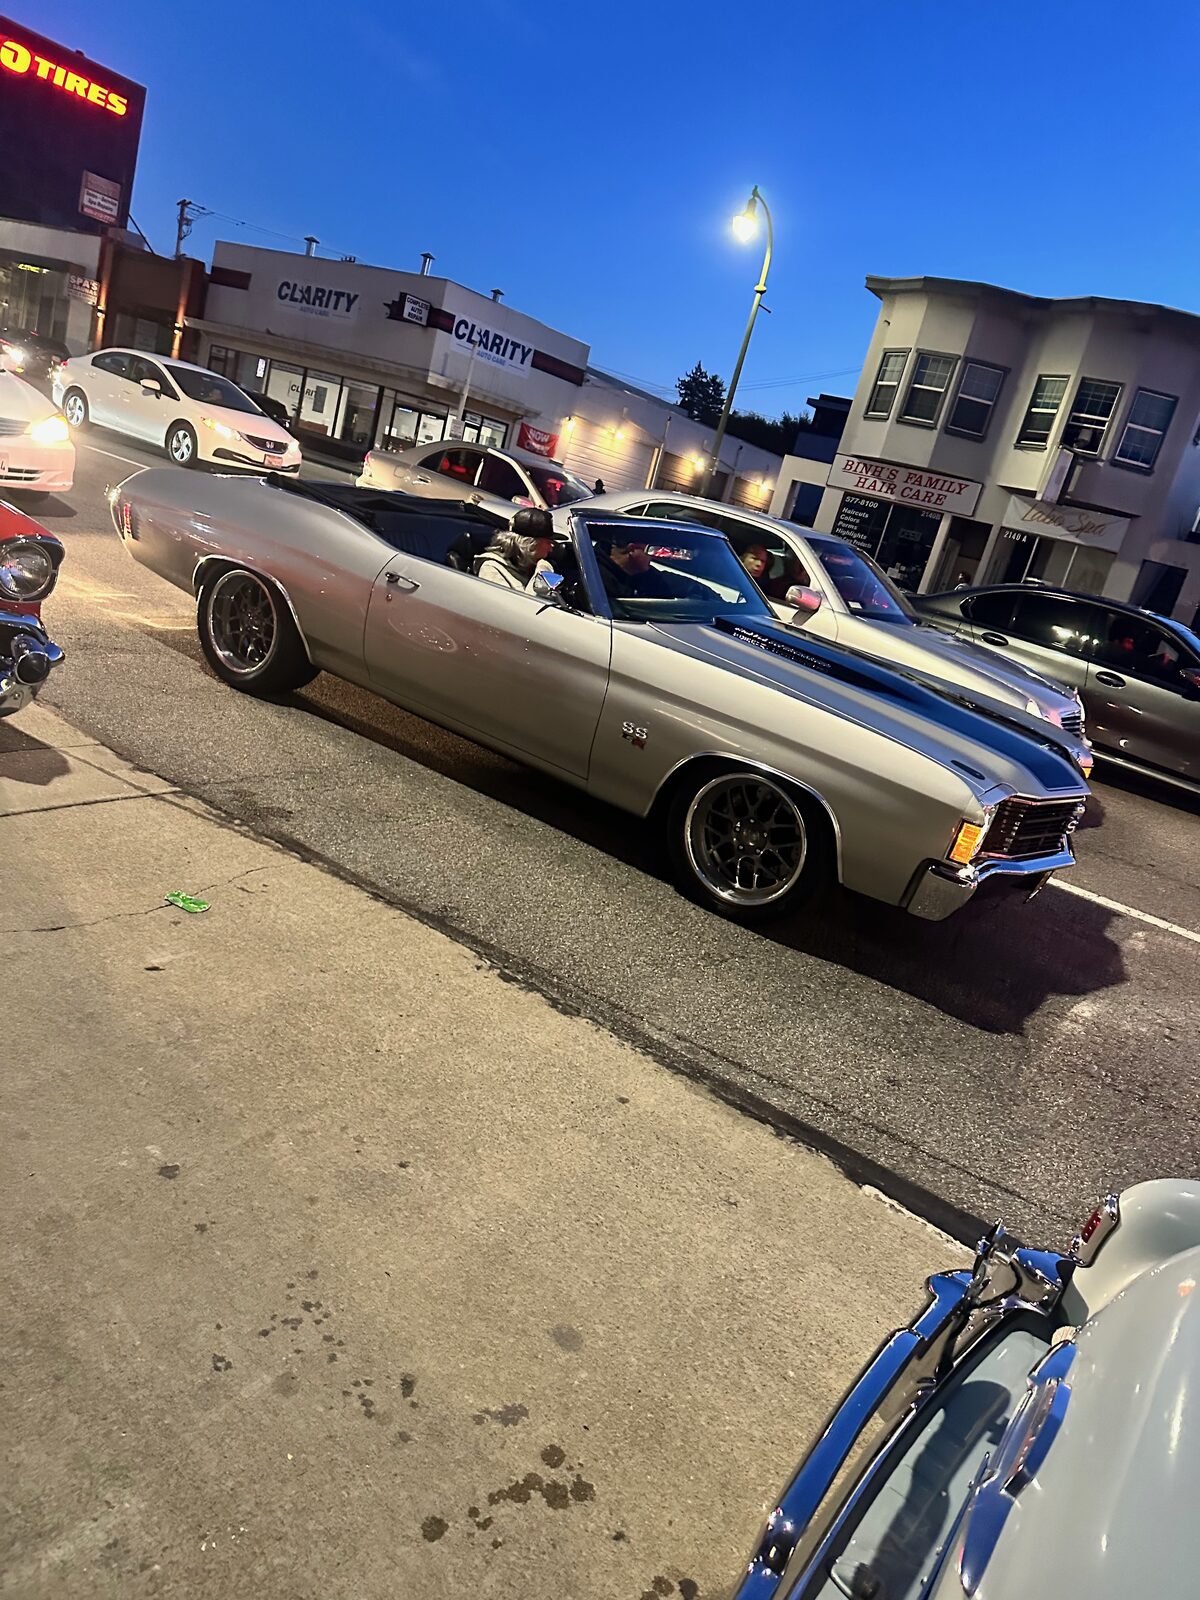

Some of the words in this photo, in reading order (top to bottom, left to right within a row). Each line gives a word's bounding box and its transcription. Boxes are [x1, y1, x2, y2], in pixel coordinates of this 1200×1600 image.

[34, 55, 128, 116] TIRES
[277, 280, 360, 313] CLARITY
[454, 318, 533, 366] CLARITY
[476, 350, 492, 361] AUTO
[529, 428, 550, 443] NOW
[842, 459, 899, 481] BINH'S
[903, 471, 970, 496] FAMILY
[854, 476, 897, 496] HAIR
[900, 486, 948, 507] CARE
[845, 495, 879, 510] 577-8100
[839, 514, 860, 524] Colors
[842, 506, 870, 519] Haircuts
[835, 527, 868, 540] Highlights
[837, 521, 858, 531] Perms
[622, 721, 648, 739] SS
